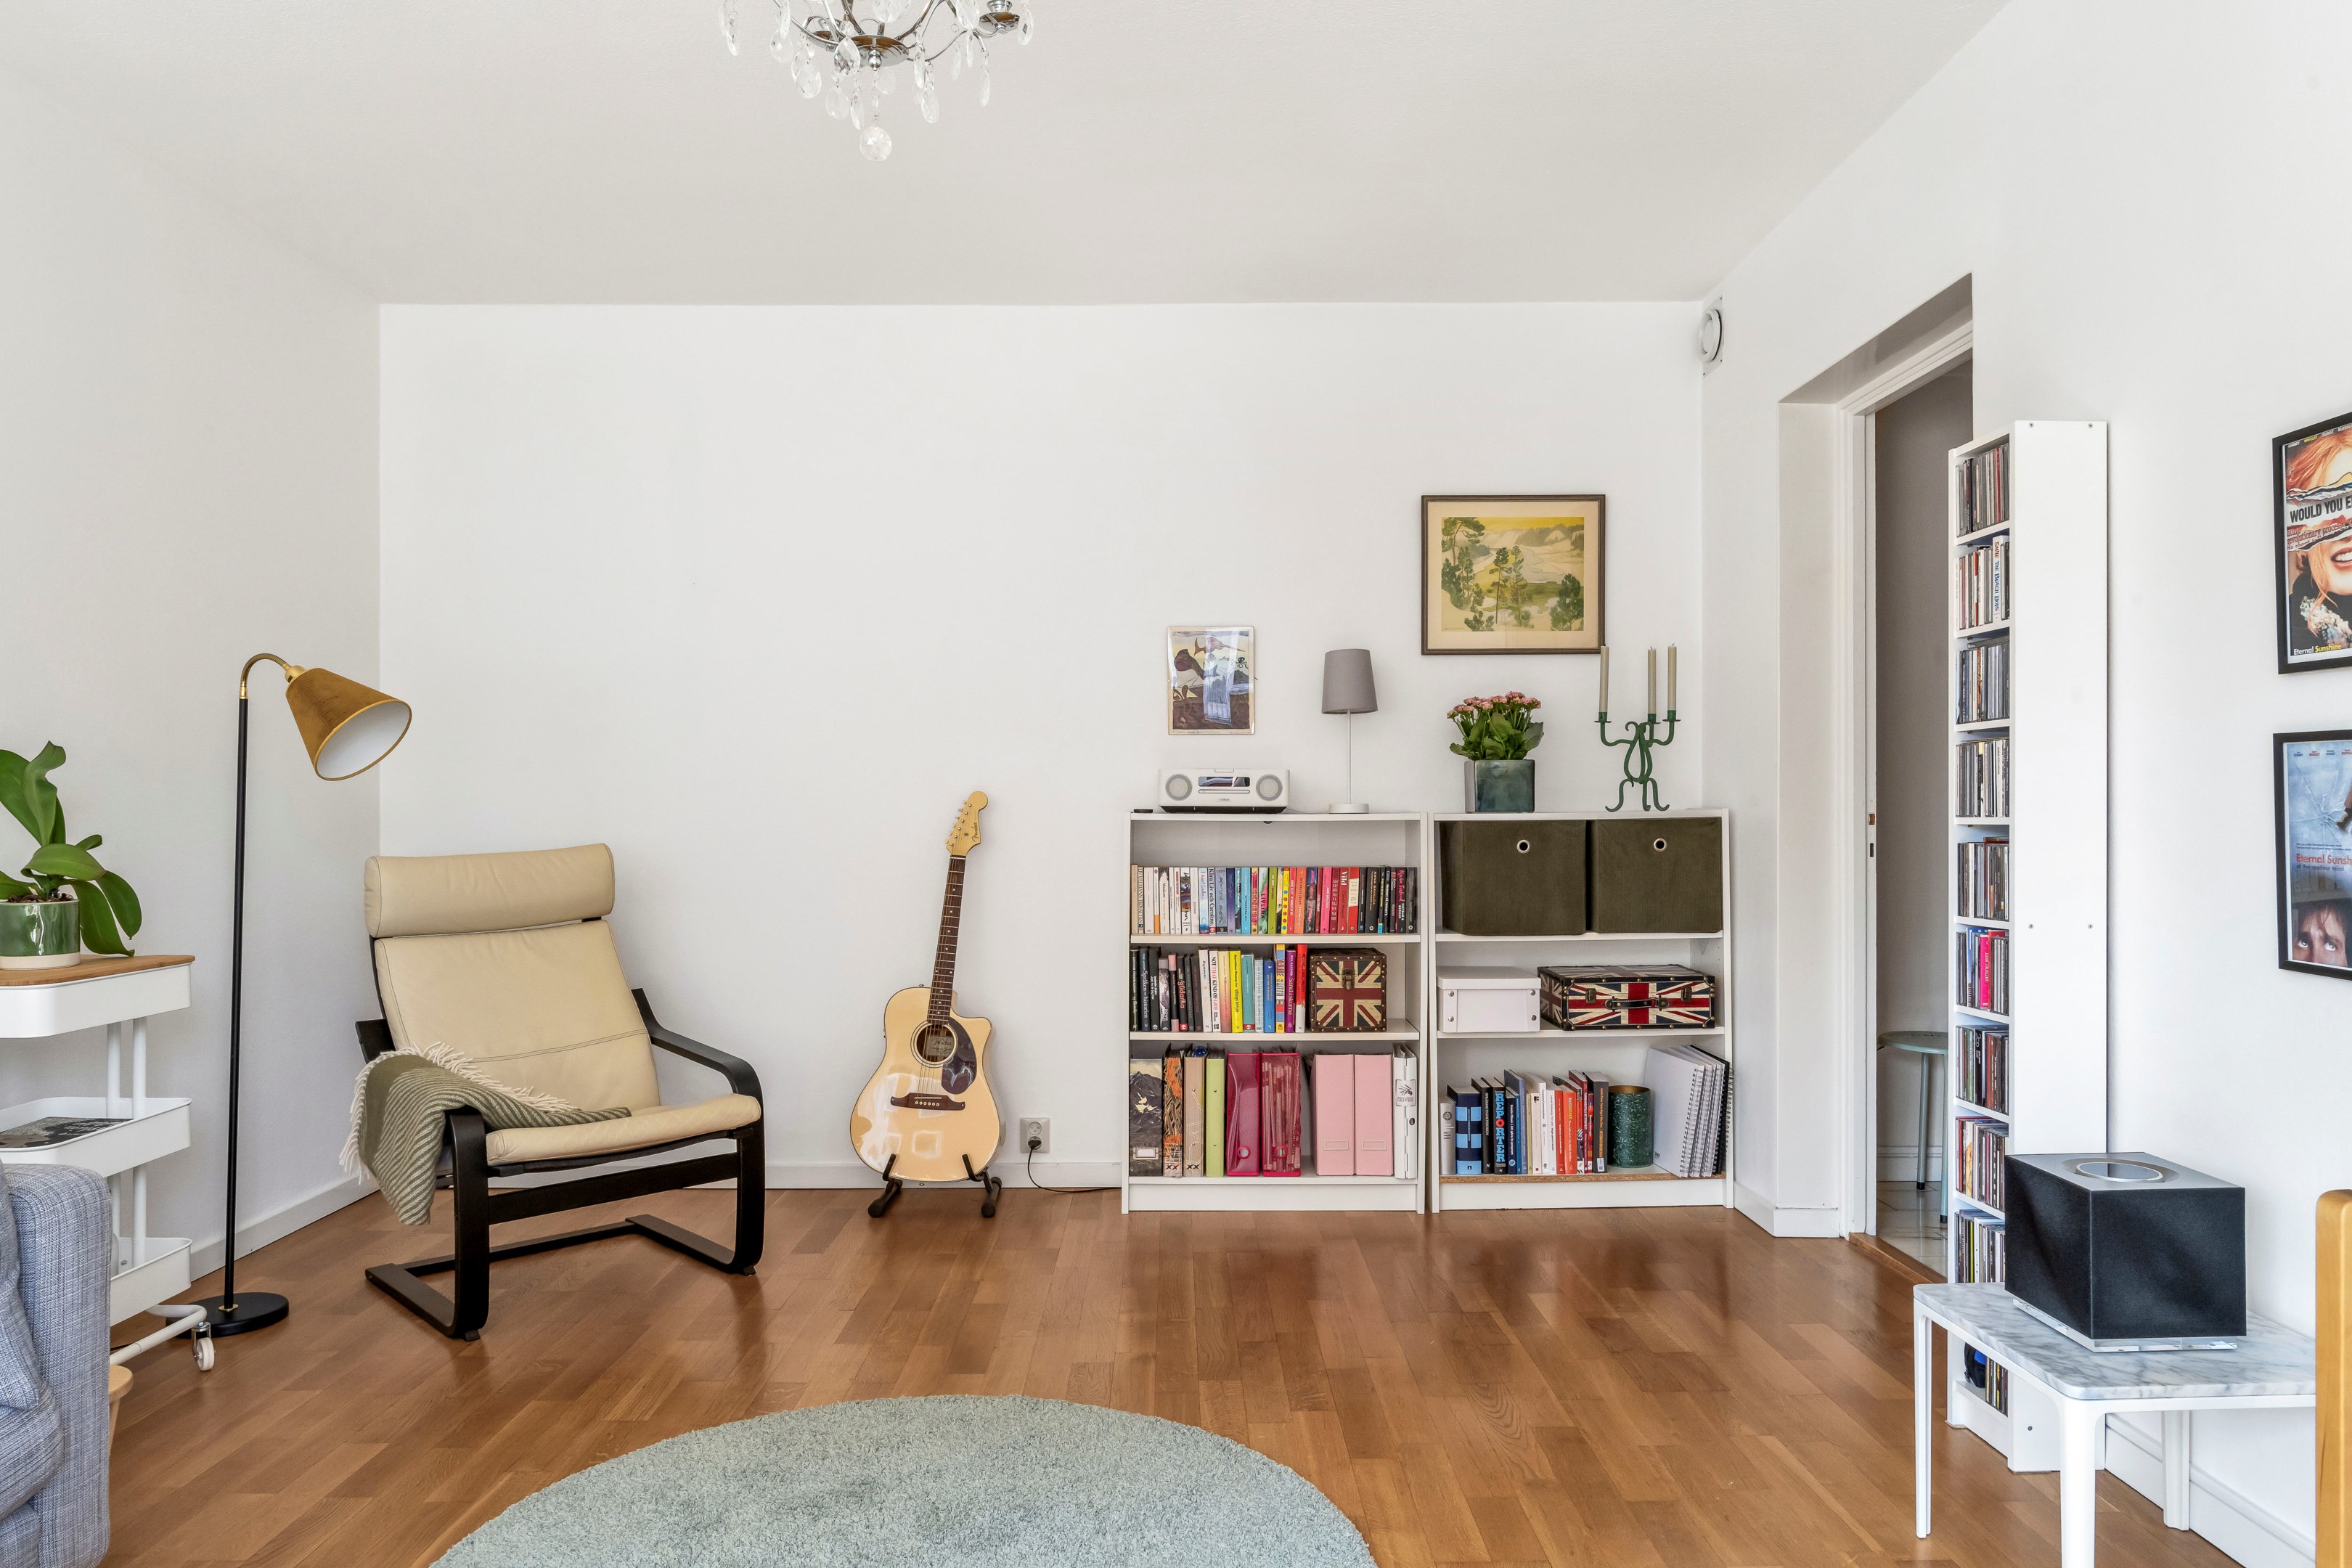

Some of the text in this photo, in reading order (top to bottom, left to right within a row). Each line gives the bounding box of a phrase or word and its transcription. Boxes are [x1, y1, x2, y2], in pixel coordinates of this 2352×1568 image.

[2290, 504, 2322, 523] WOULD
[2324, 498, 2343, 514] YOU
[2293, 643, 2342, 655] Eternal Sunshine
[2296, 854, 2324, 863] Eternal
[1495, 1093, 1506, 1162] REPORTER
